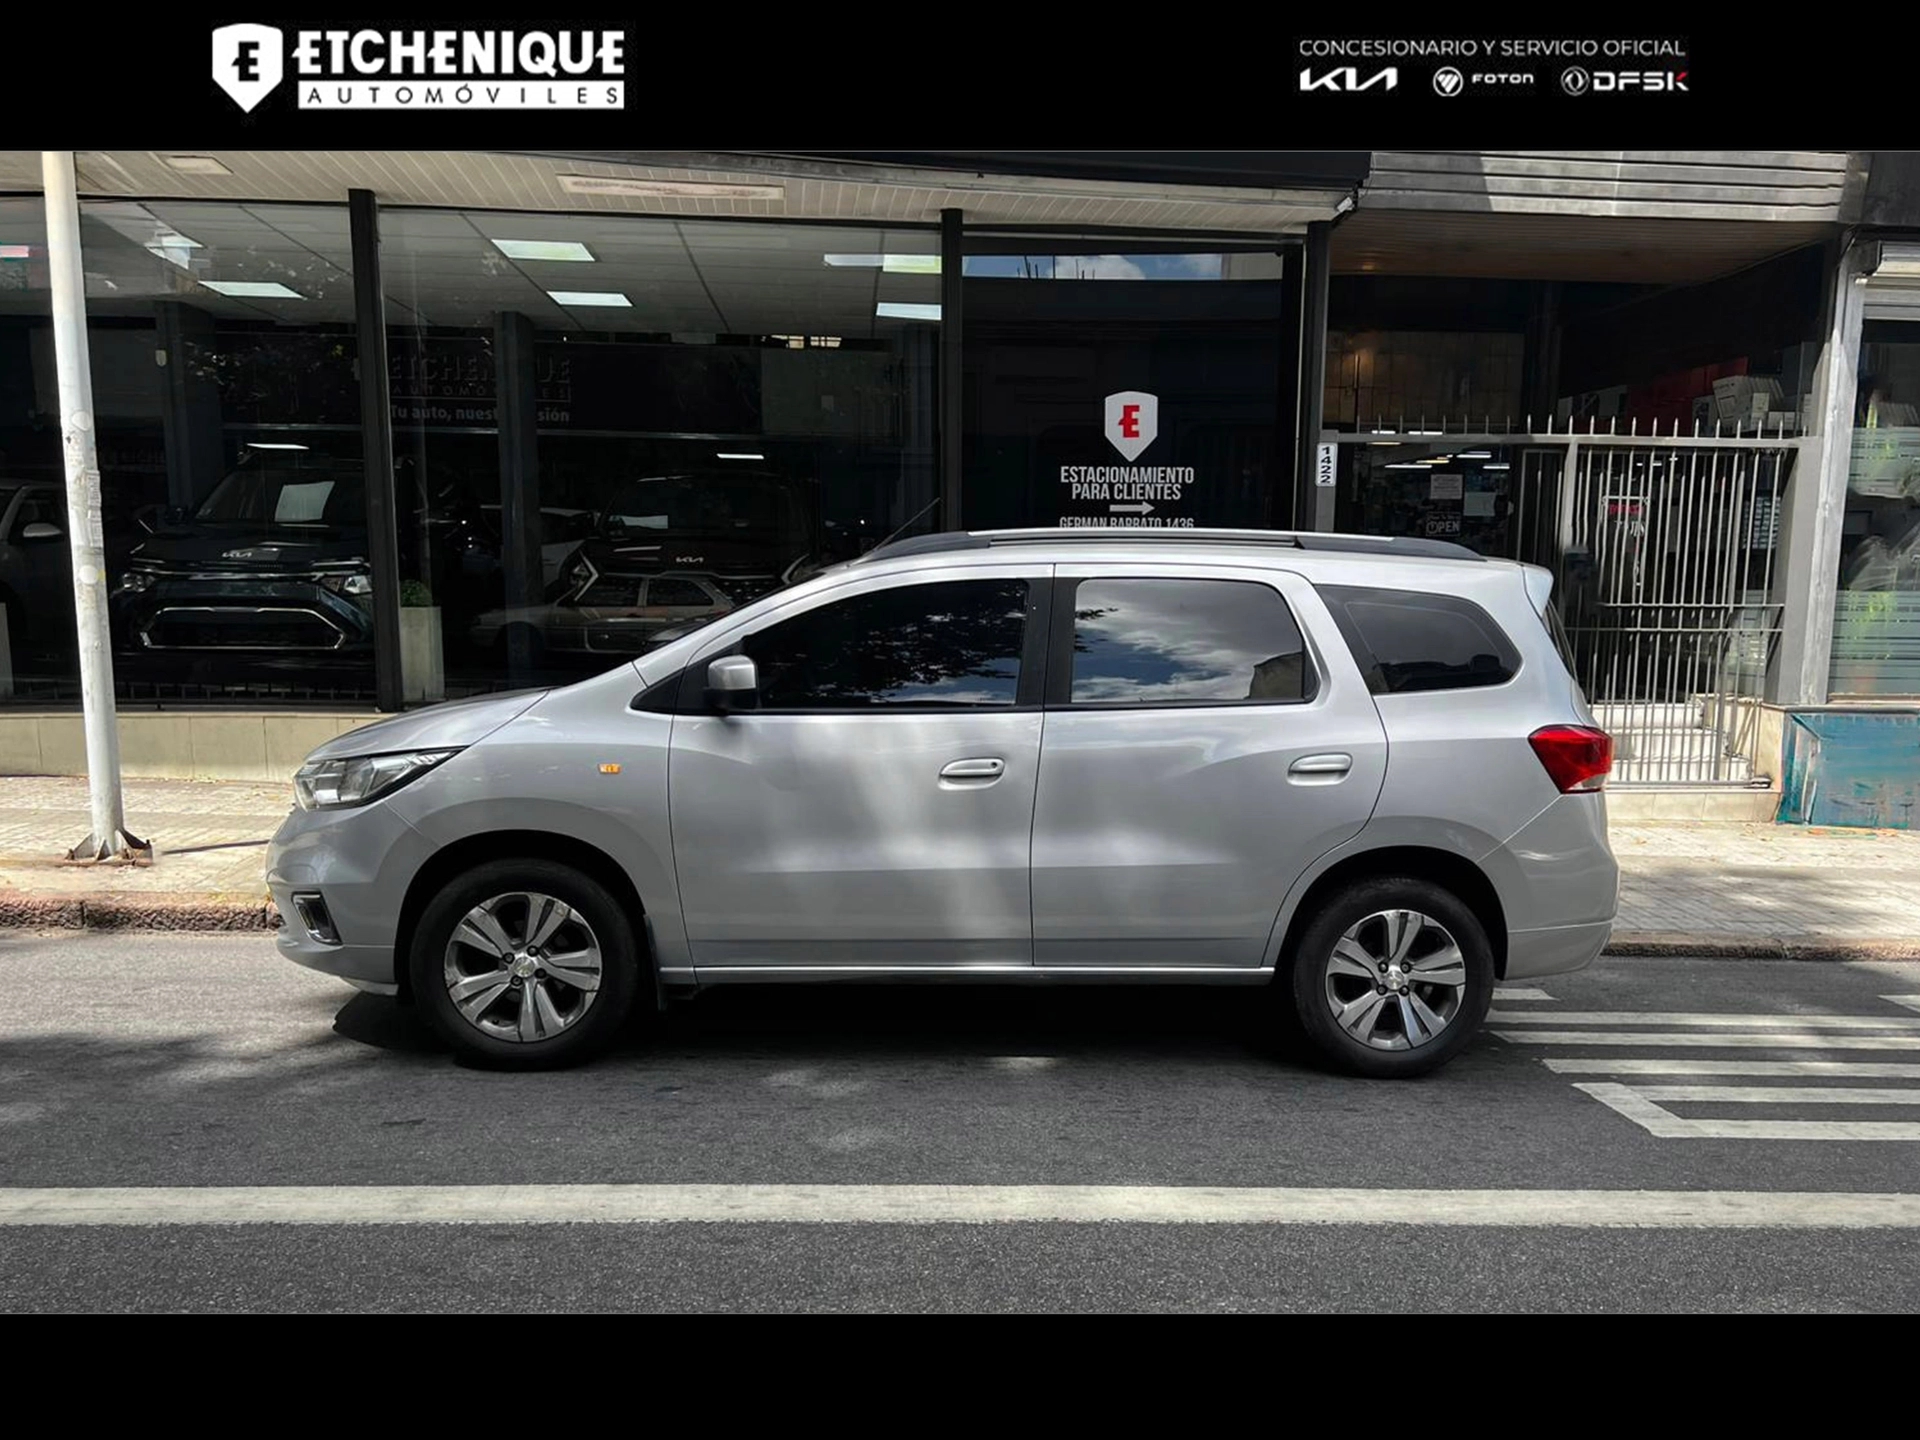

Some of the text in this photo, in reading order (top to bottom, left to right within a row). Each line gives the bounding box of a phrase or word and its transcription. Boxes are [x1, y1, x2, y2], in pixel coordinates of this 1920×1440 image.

[1320, 446, 1332, 484] 1422
[1060, 466, 1195, 484] ESTACIONAMIENTO
[1072, 483, 1182, 500] PARA CLIENTES
